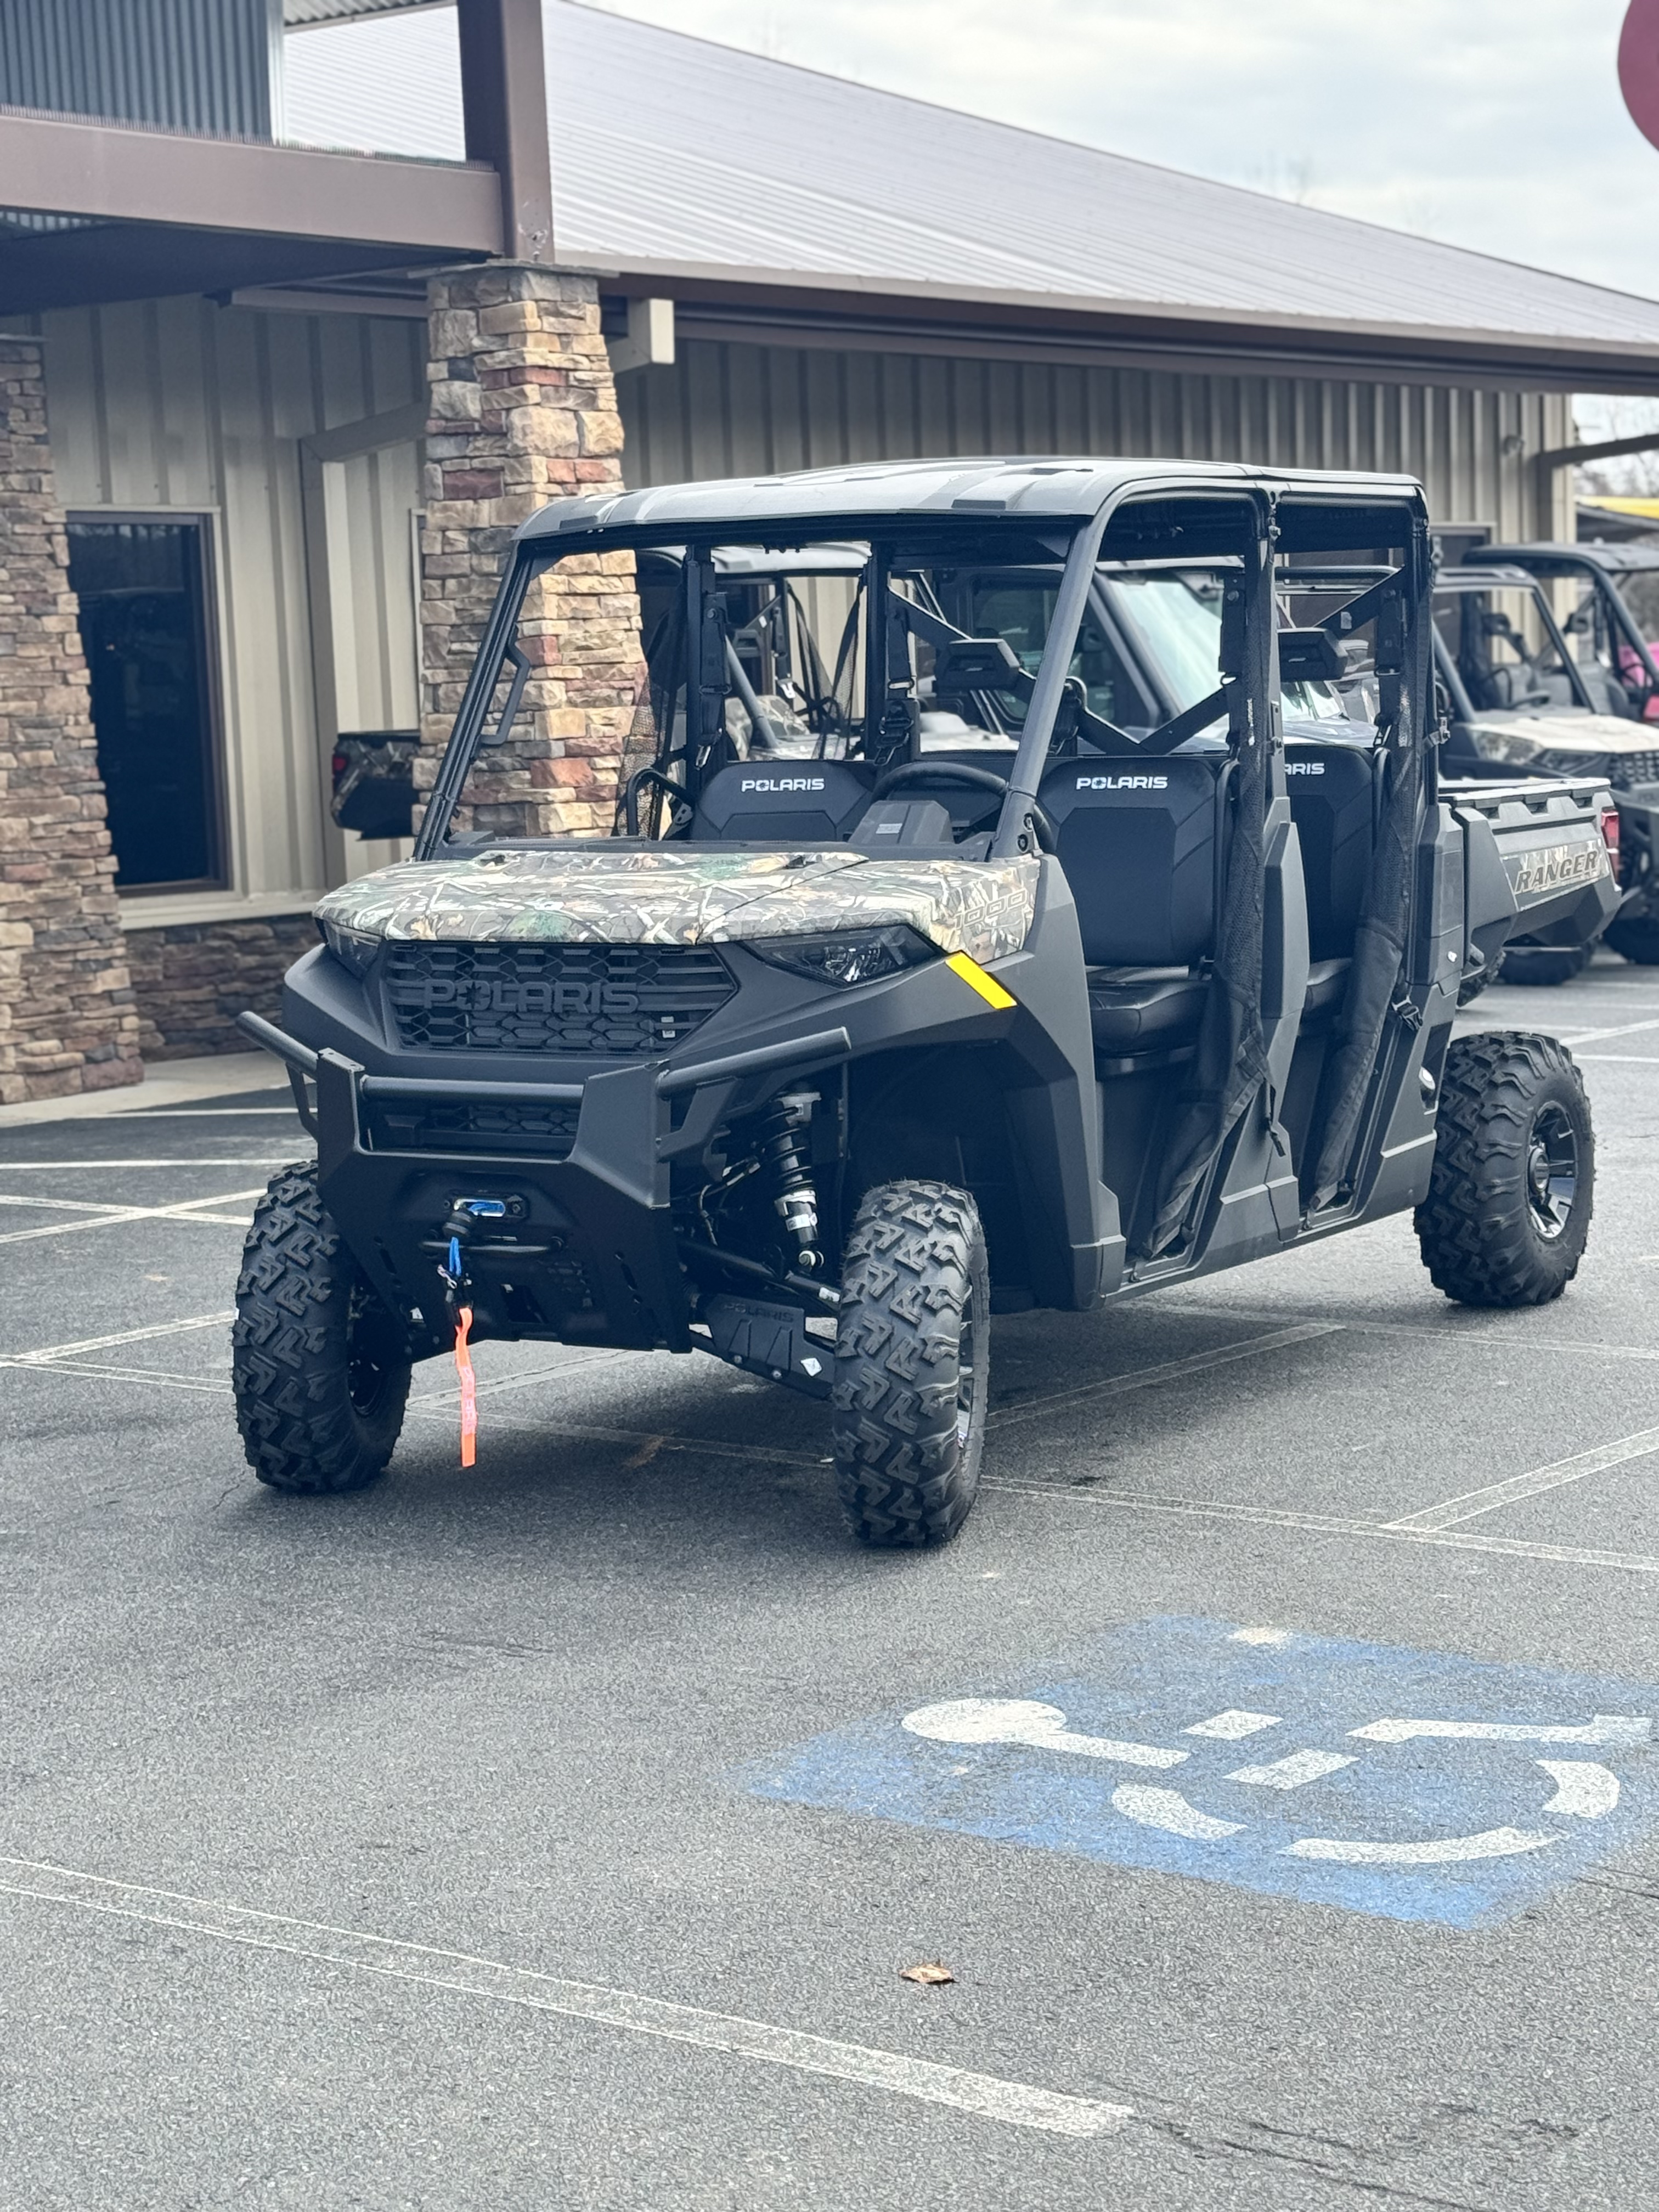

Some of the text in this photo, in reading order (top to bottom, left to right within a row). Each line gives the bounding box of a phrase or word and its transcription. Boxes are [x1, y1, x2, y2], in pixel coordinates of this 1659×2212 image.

[1284, 763, 1325, 775] ARIS
[742, 778, 825, 792] POLARIS
[1076, 776, 1168, 790] POLARIS
[1515, 850, 1599, 893] RANGER
[424, 979, 639, 1014] POLARIS
[724, 1304, 794, 1323] POLARIS
